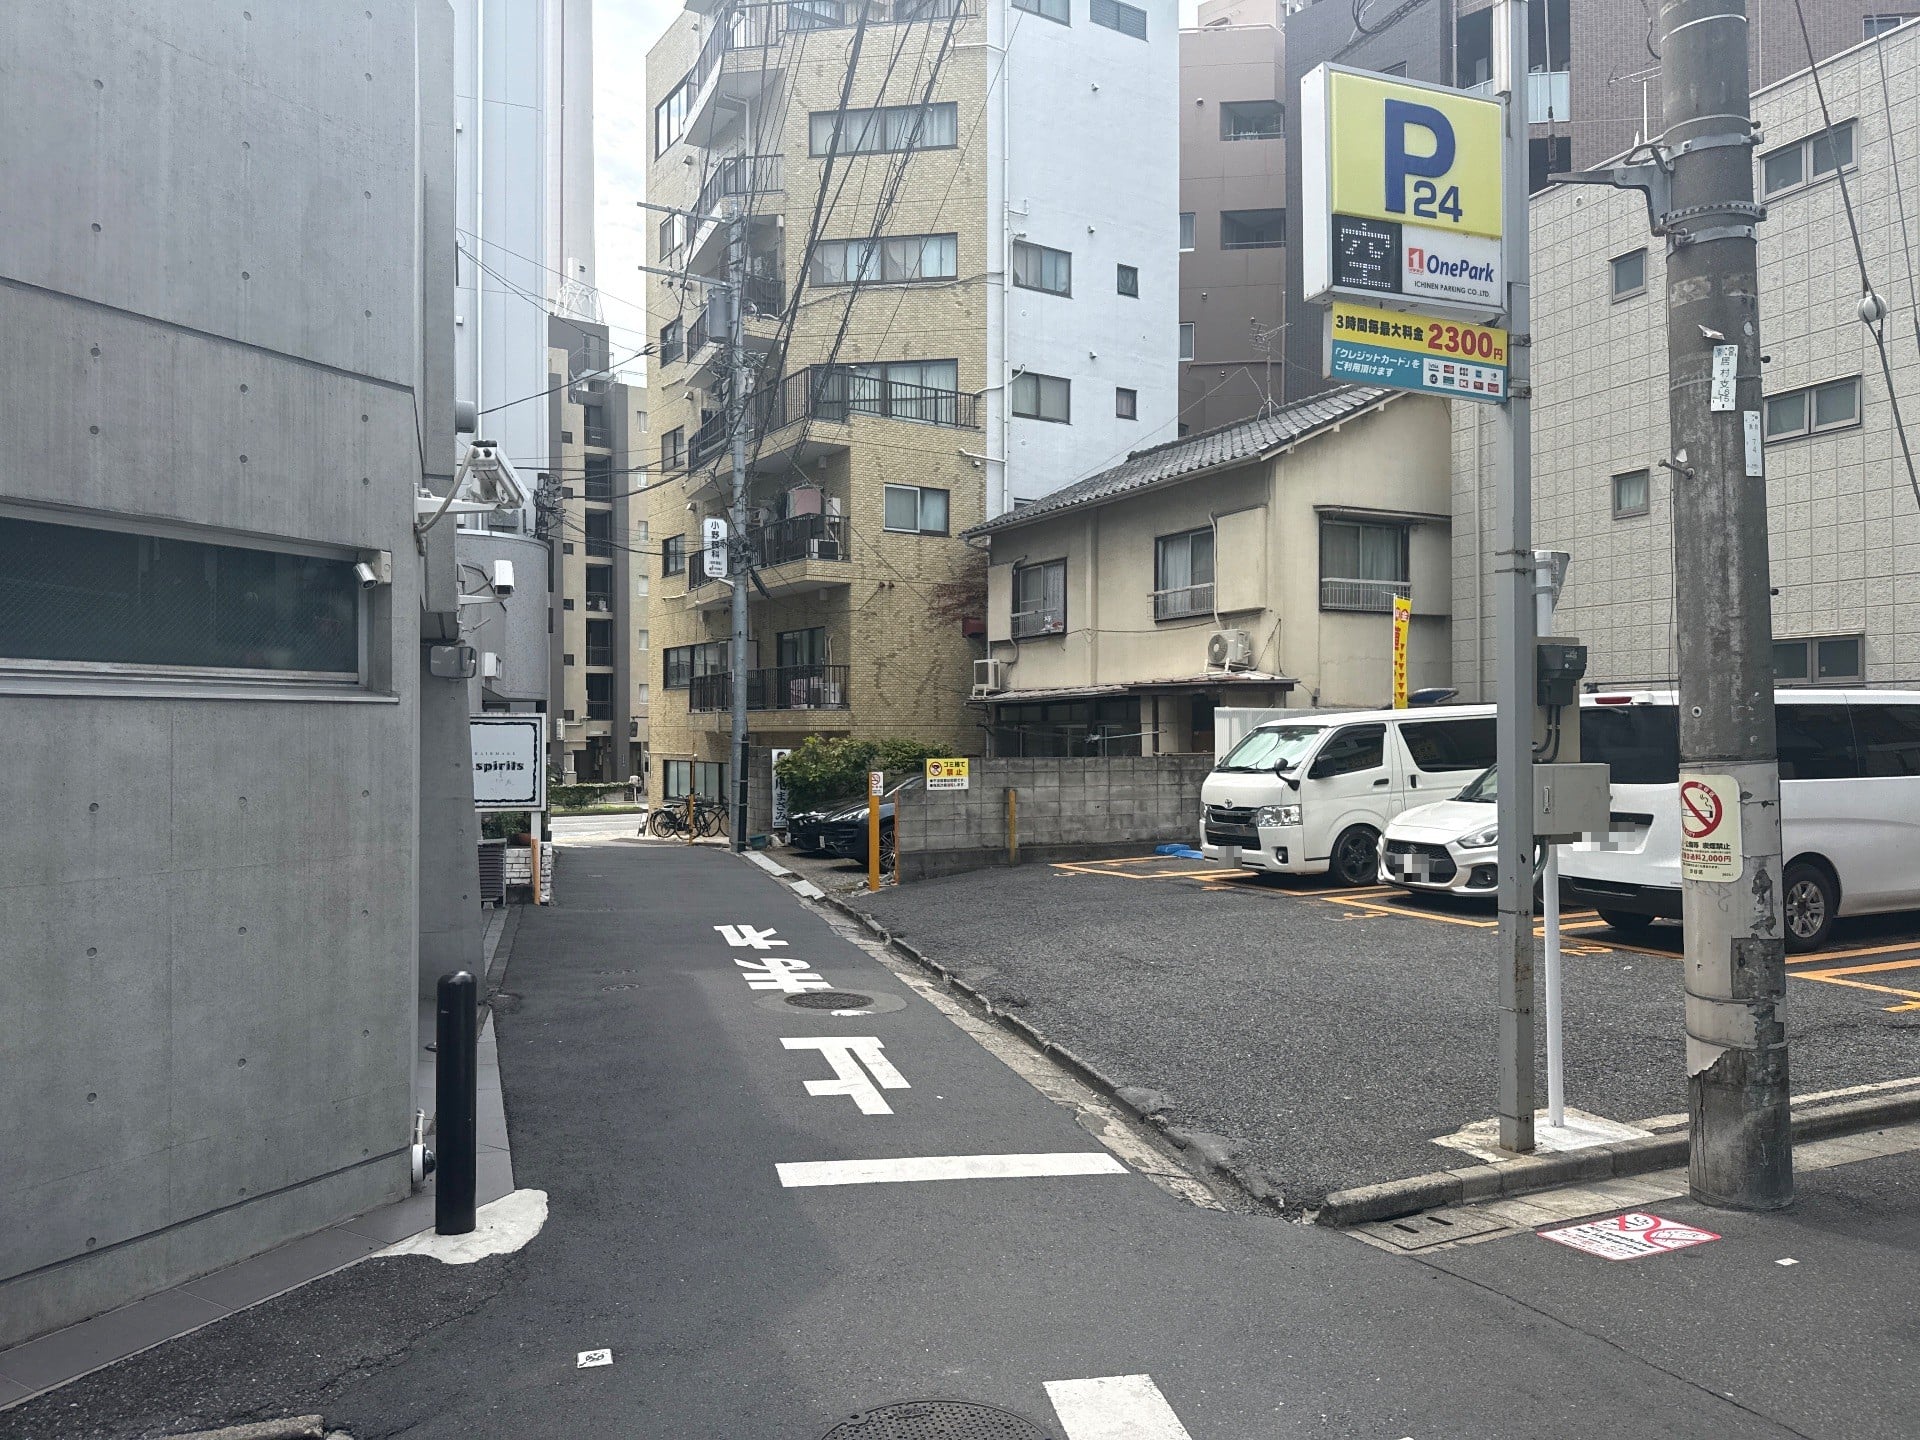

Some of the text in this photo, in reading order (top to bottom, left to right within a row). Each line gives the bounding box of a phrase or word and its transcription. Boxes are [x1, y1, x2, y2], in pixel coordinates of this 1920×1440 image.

[1384, 98, 1456, 214] P
[1413, 180, 1463, 223] 24
[1340, 223, 1391, 289] 空
[1427, 254, 1494, 283] OnePark
[1414, 280, 1439, 290] ICHINEN
[1440, 284, 1466, 294] PARKING
[1336, 315, 1503, 361] 3時間毎最大料金 2300円
[1335, 360, 1394, 378] ご利用頂けます
[475, 760, 525, 773] spirits
